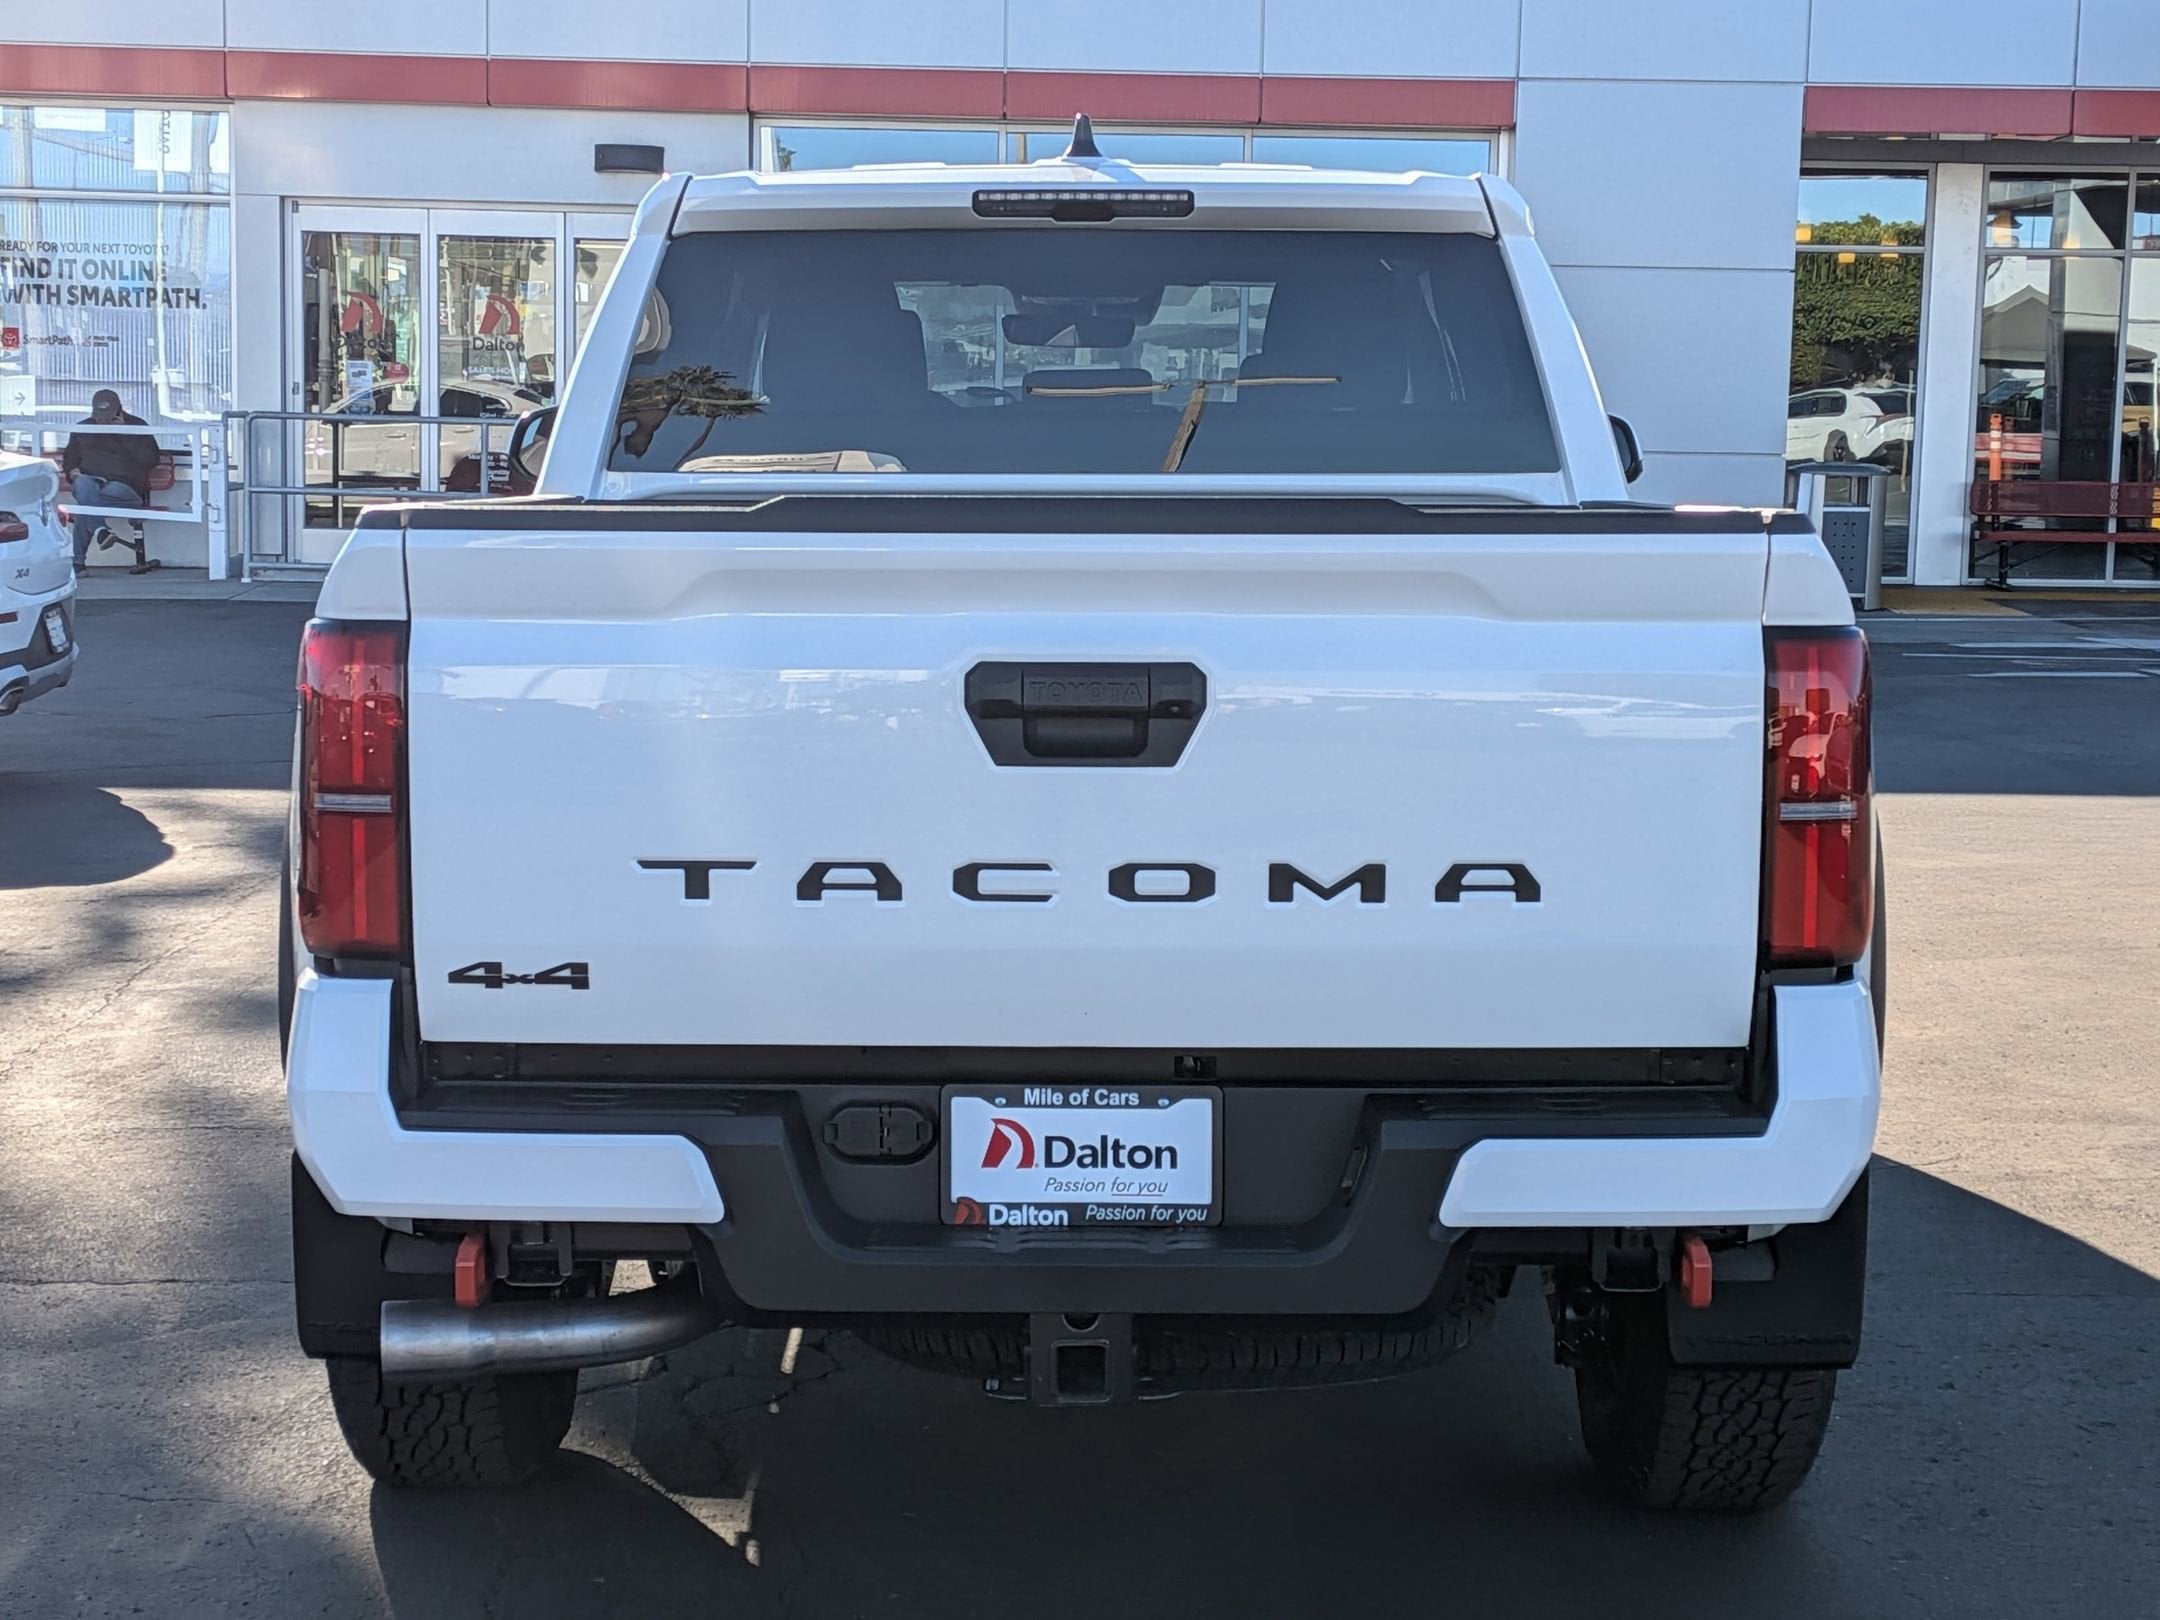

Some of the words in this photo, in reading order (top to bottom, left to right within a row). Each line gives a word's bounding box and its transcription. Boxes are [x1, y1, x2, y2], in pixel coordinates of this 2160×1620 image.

[0, 240, 33, 252] READY
[36, 241, 57, 253] FOR
[60, 242, 90, 254] YOUR
[93, 243, 120, 255] NEXT
[0, 256, 52, 279] FIND
[58, 258, 77, 280] IT
[2, 283, 61, 304] WITH
[67, 285, 207, 310] SMARTPATH.
[23, 335, 74, 346] SmartPath
[473, 337, 525, 351] Dalton
[1029, 681, 1143, 701] TOYOTA
[636, 859, 1541, 904] TACOMA
[1023, 1088, 1064, 1106] Mile
[1069, 1088, 1090, 1106] of
[1094, 1089, 1140, 1106] Cars
[1044, 1135, 1178, 1170] Dalton
[1044, 1177, 1106, 1193] Passion
[1111, 1177, 1135, 1194] for
[1138, 1180, 1168, 1194] you
[988, 1204, 1069, 1226] Dalton
[1085, 1205, 1146, 1221] Passion
[1150, 1205, 1175, 1221] for
[1178, 1207, 1207, 1222] you
